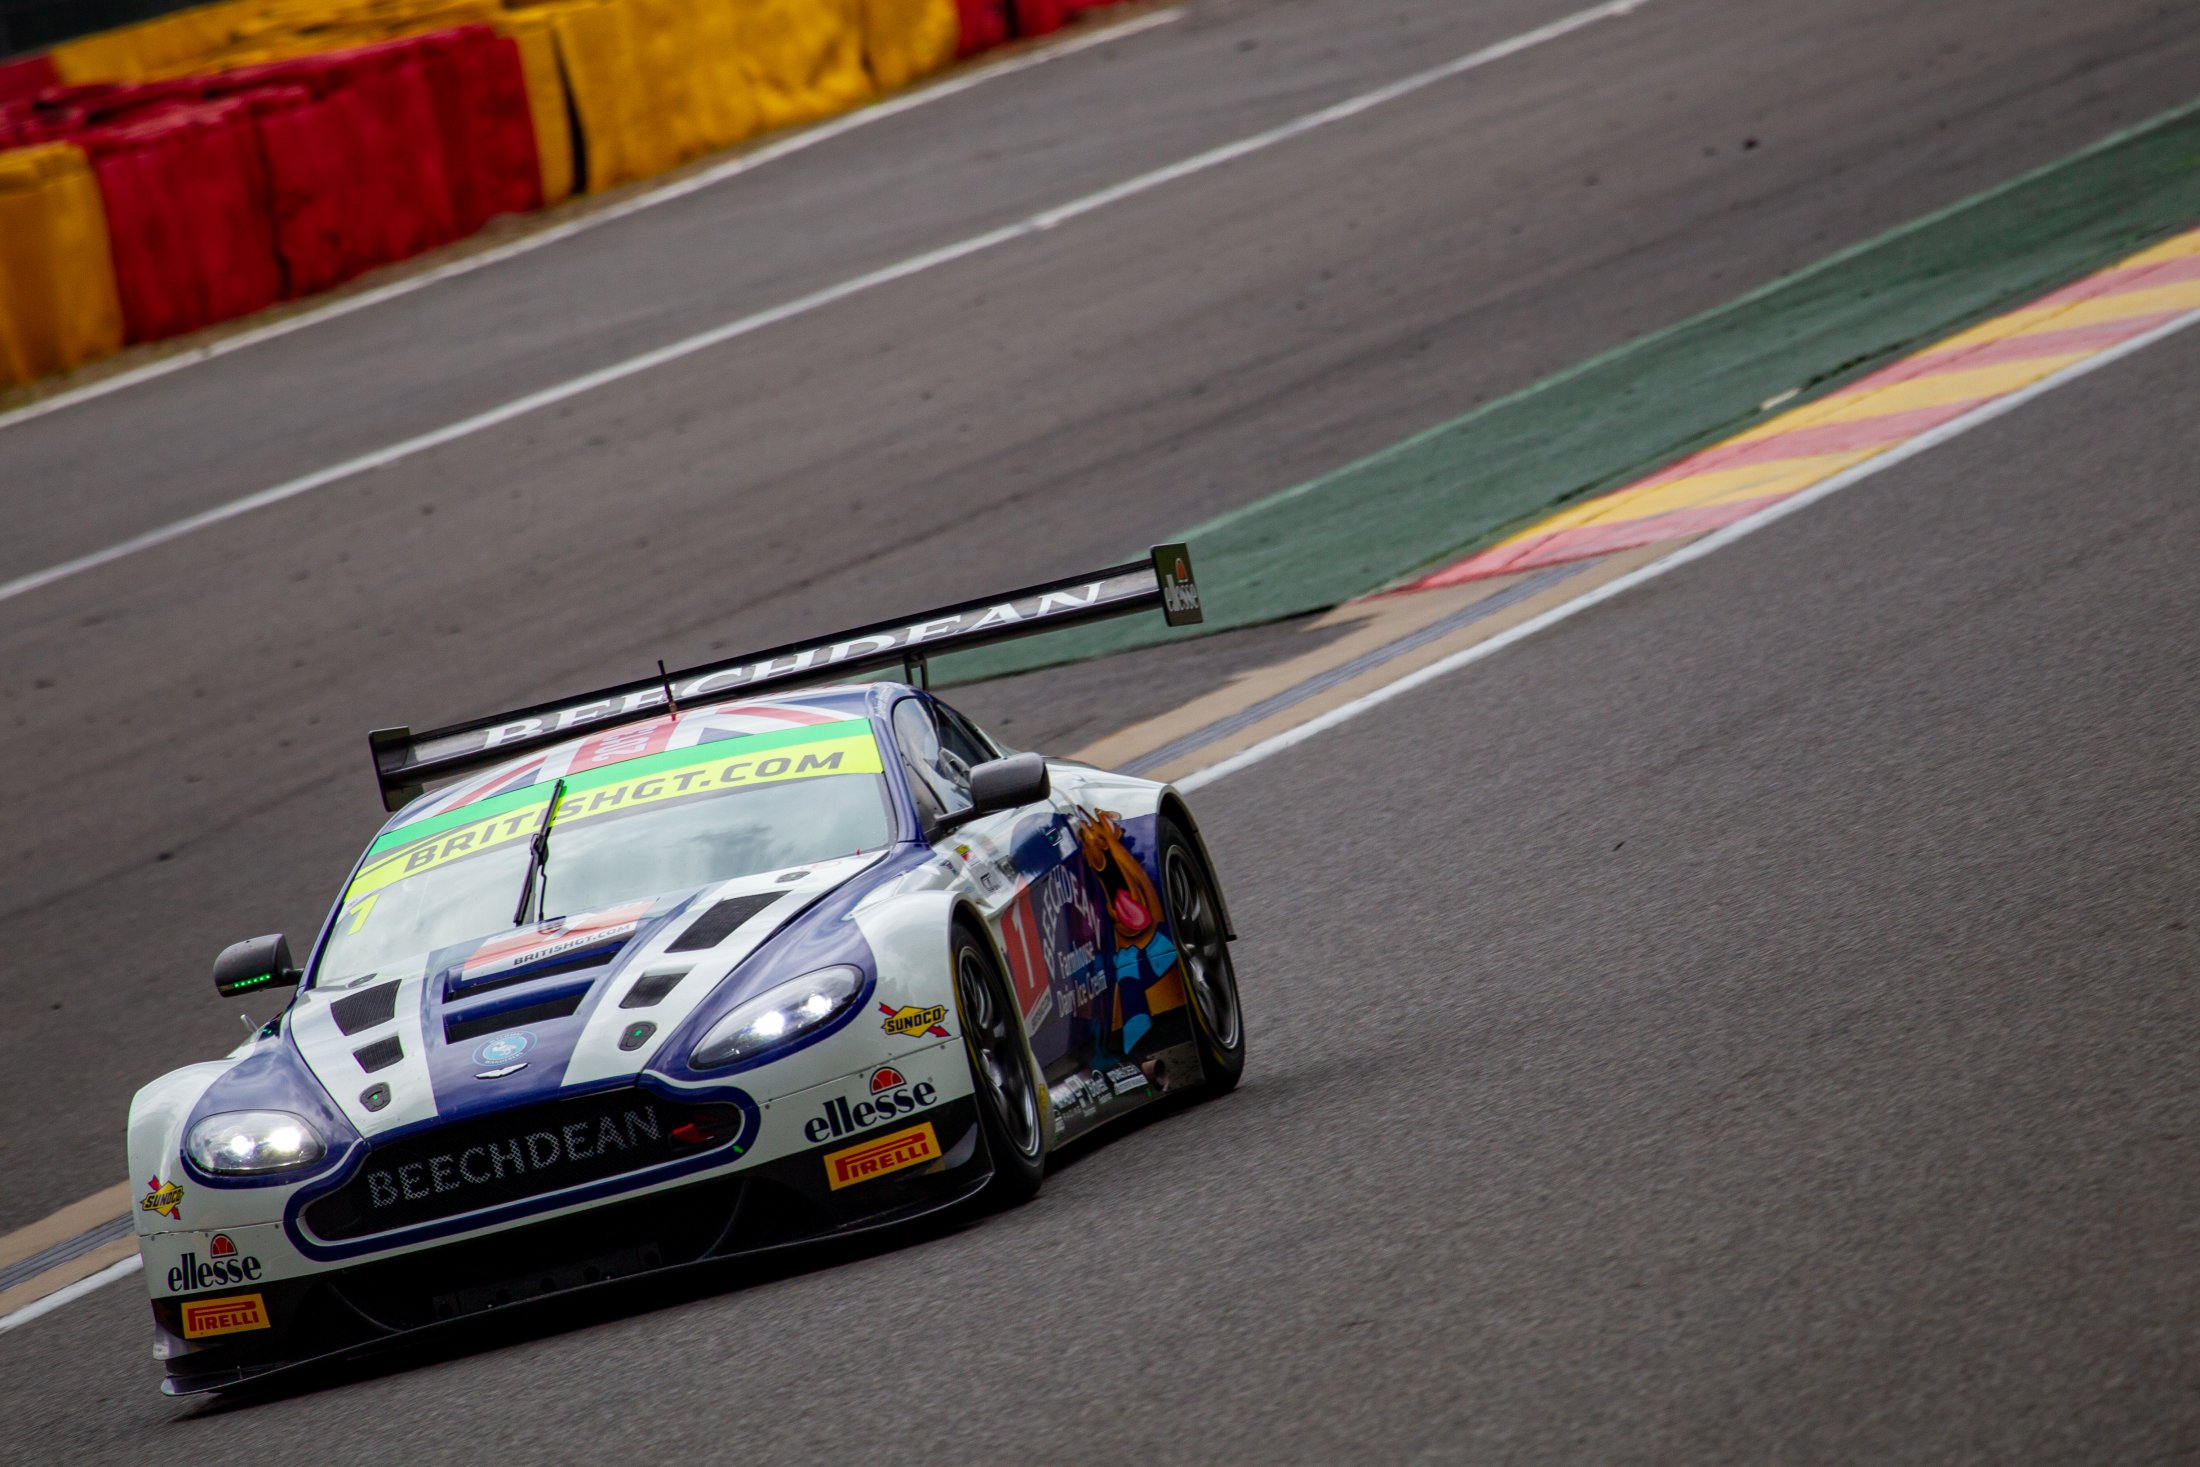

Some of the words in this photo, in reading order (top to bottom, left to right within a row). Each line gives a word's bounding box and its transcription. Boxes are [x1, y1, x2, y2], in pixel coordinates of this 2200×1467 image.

[481, 580, 1107, 749] BEECHDEAN
[513, 923, 632, 966] BRITISHGT.COM
[1011, 873, 1035, 989] 1
[1042, 863, 1101, 982] BEECHDEAN
[887, 1007, 942, 1032] SUNOCO
[804, 1082, 937, 1143] ellesse
[367, 1105, 661, 1208] BEECHDEAN
[834, 1132, 930, 1182] PIRELLI
[145, 1187, 183, 1209] SUNOCO
[167, 1252, 262, 1292] ellesse
[187, 1301, 260, 1332] PIRELLI
